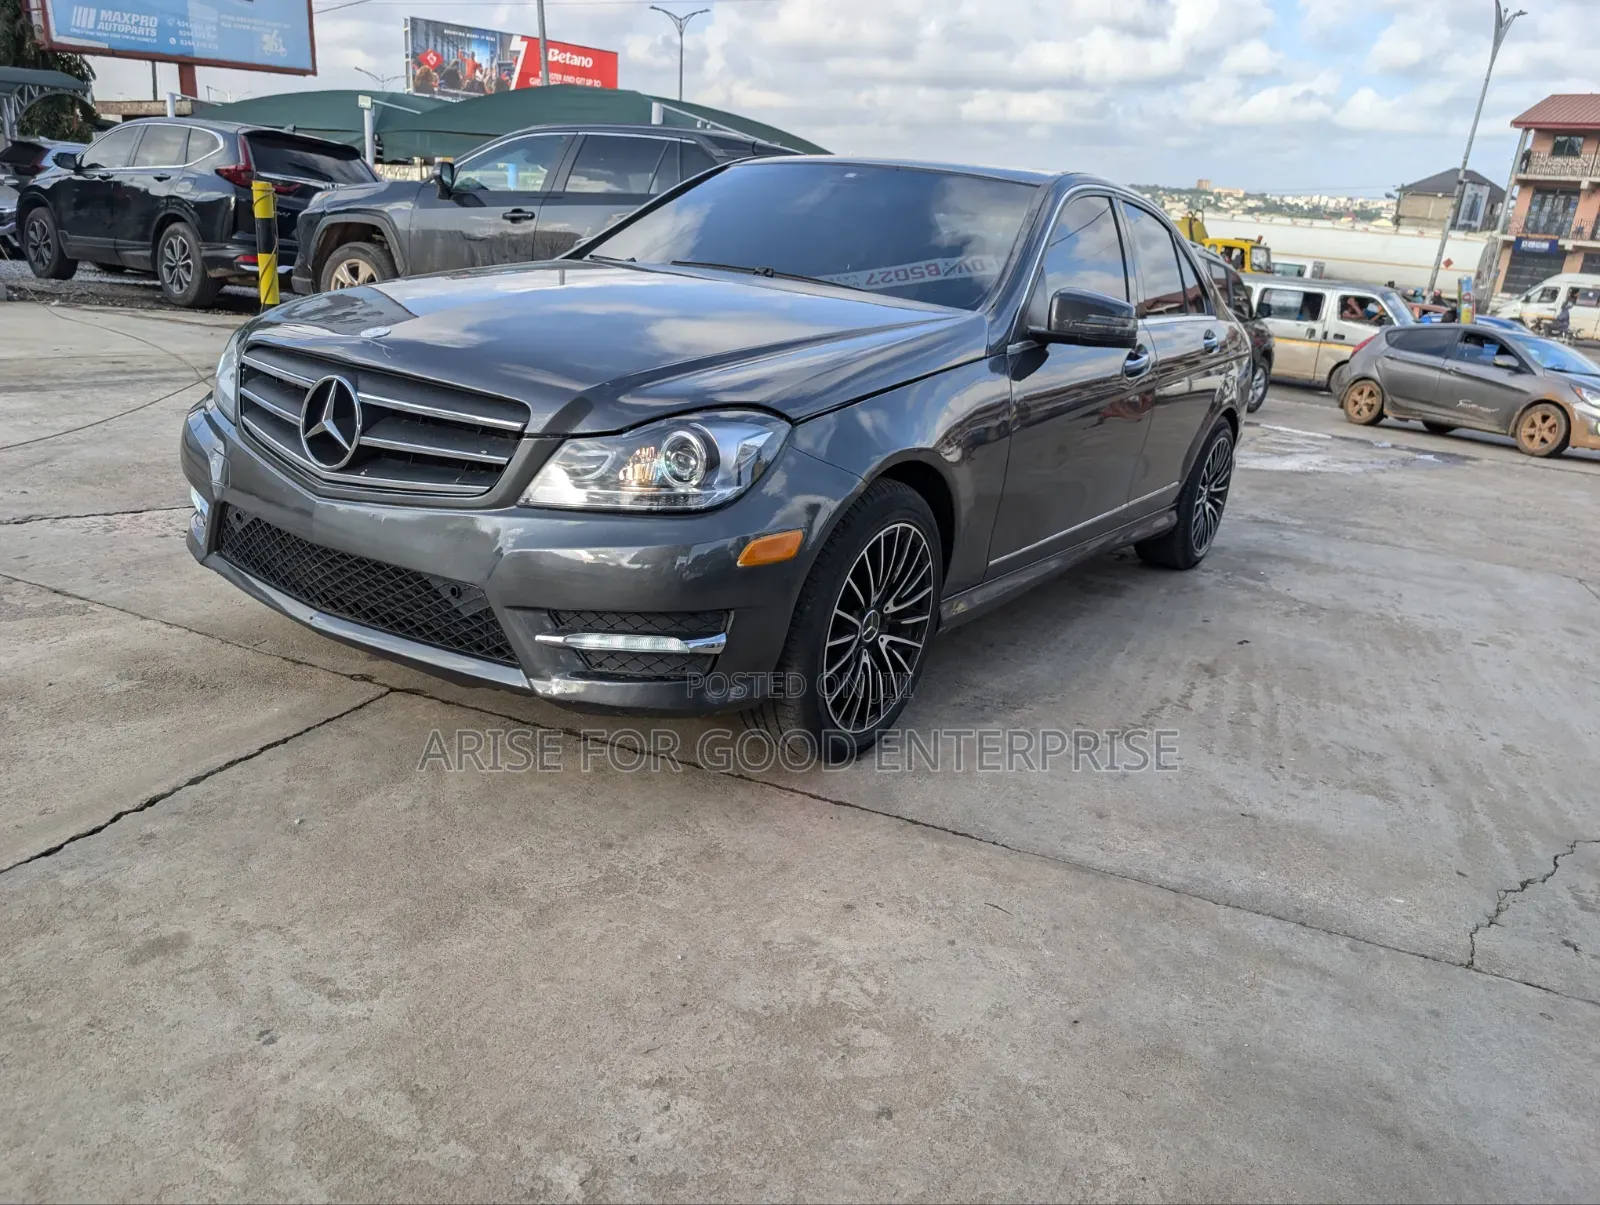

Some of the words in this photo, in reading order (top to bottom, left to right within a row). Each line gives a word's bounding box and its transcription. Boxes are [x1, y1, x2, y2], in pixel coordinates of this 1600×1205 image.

[100, 9, 158, 28] MAXPRO
[97, 21, 157, 37] AUTOPARTS
[548, 48, 593, 68] Betano
